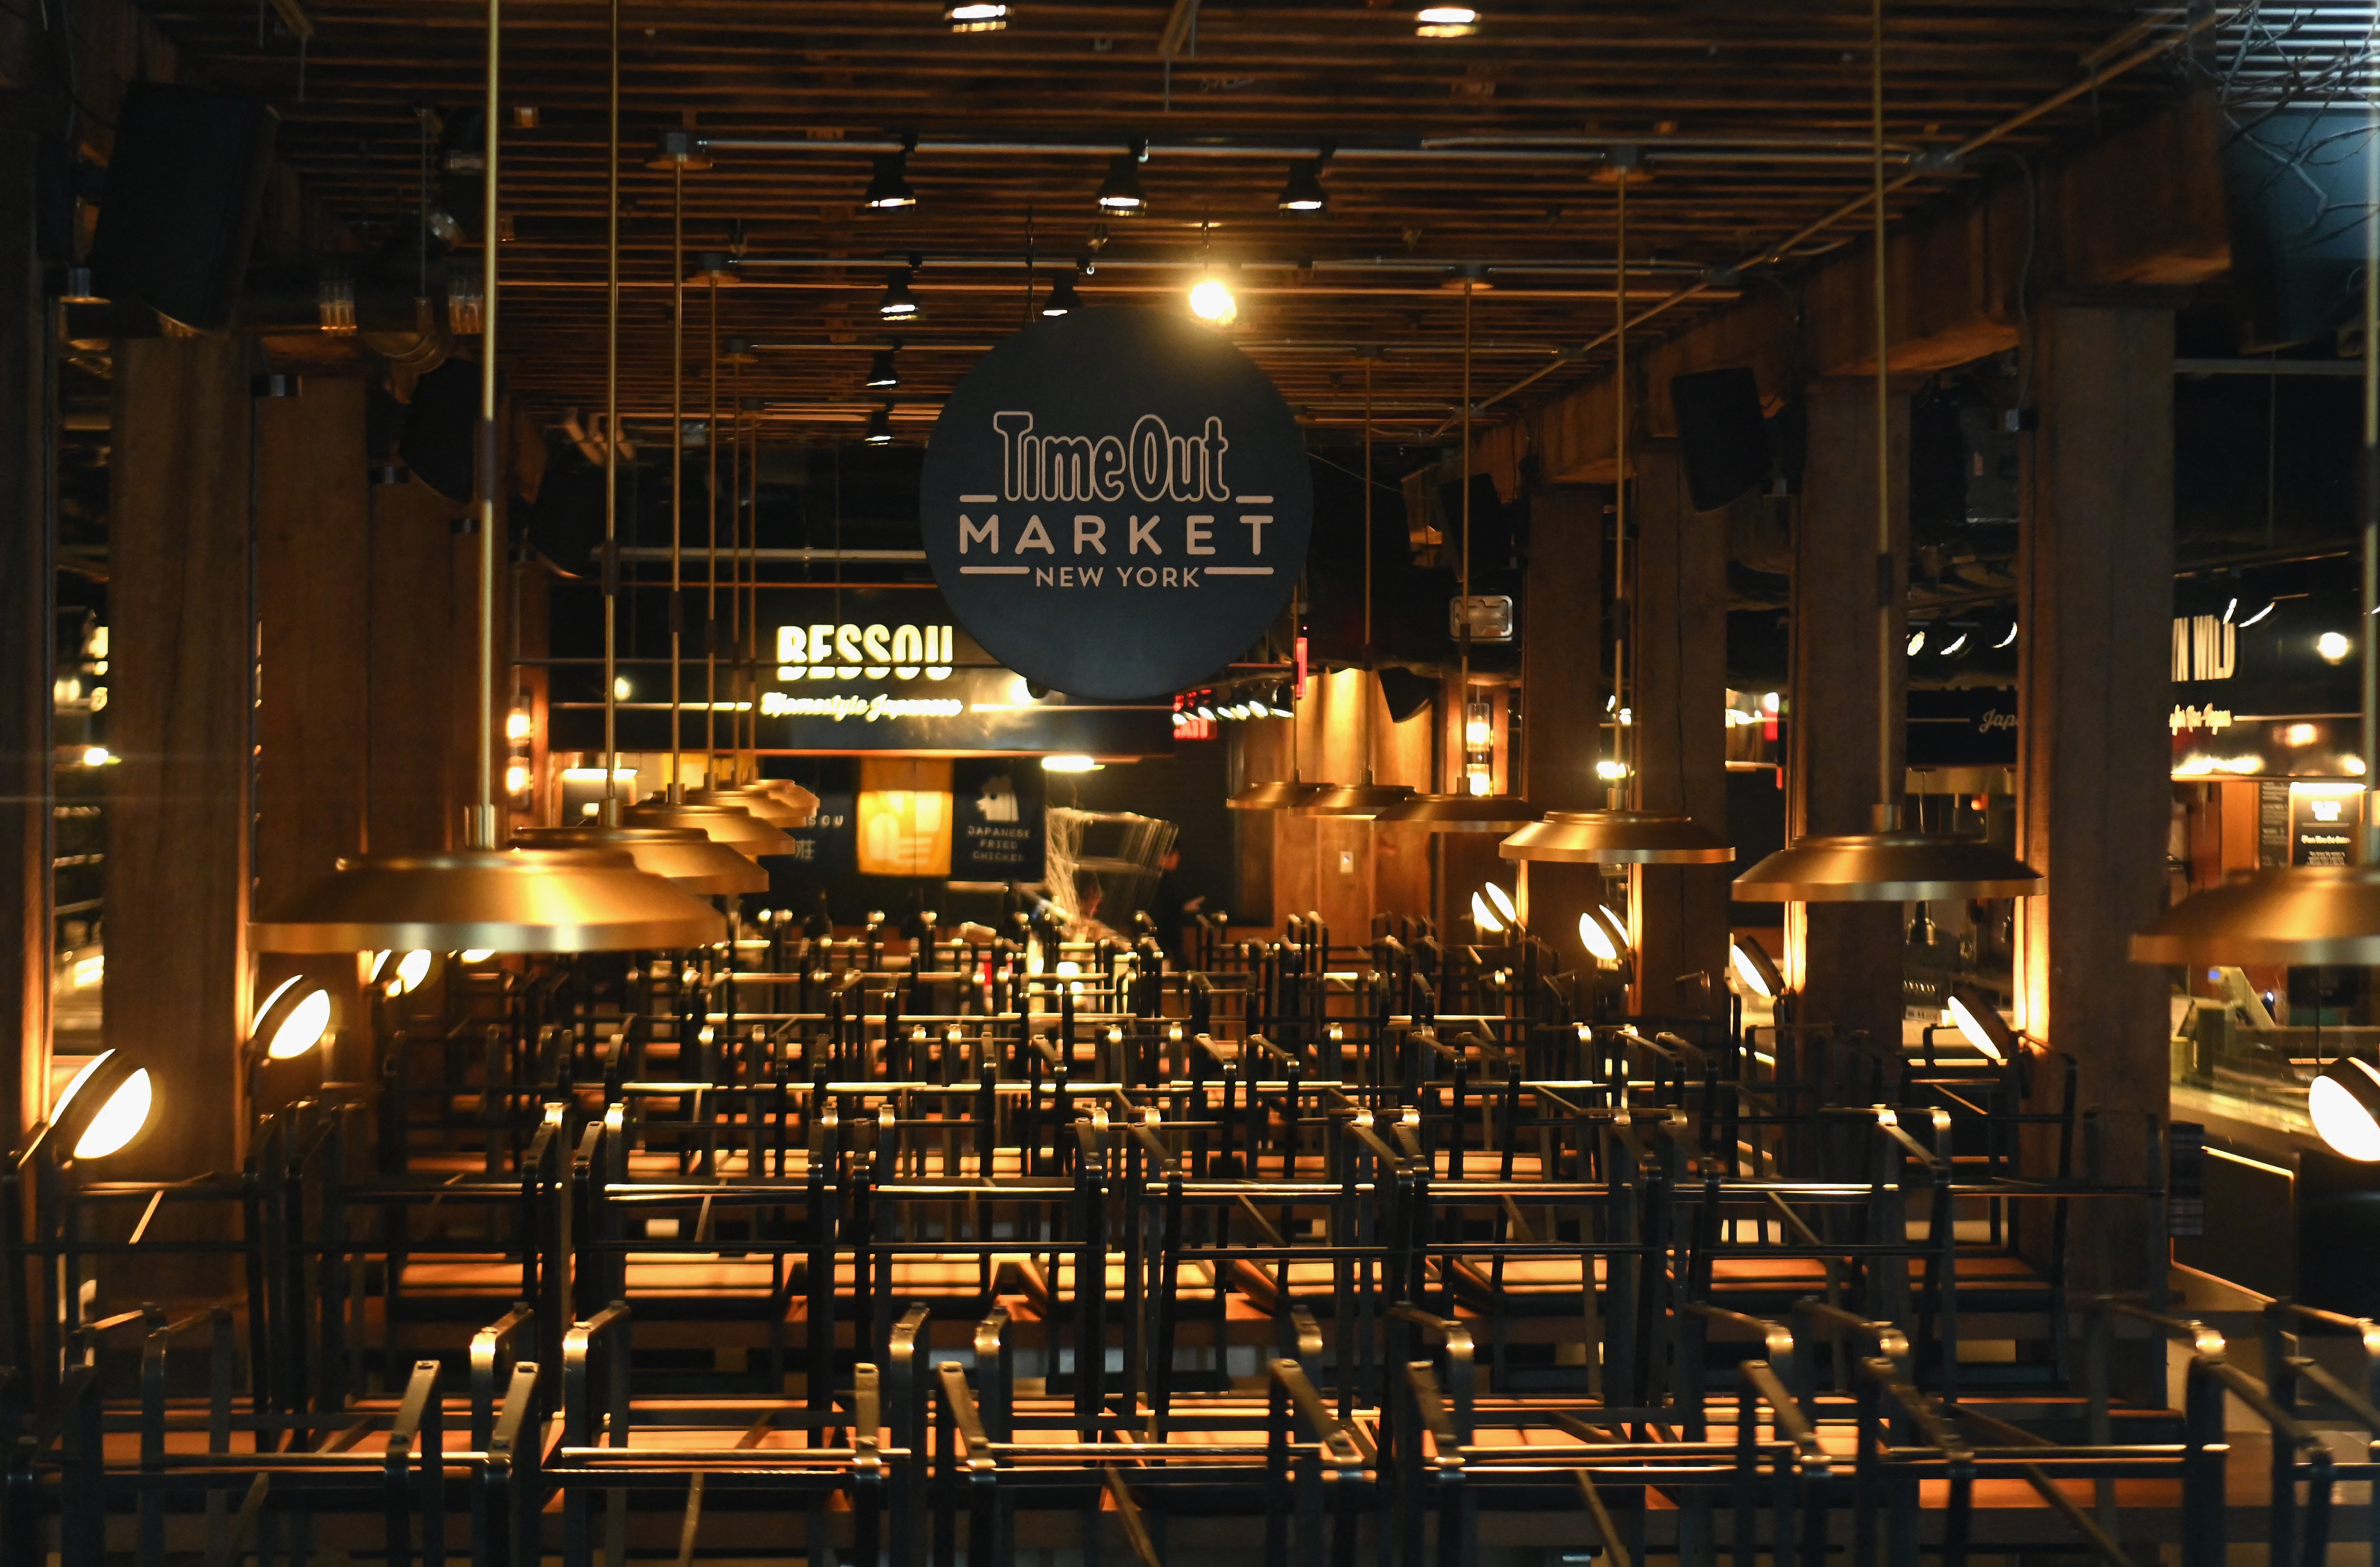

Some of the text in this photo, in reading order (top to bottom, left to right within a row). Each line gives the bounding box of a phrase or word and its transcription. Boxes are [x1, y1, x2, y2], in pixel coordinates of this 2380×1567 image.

[959, 514, 1274, 556] MARKET
[1036, 566, 1200, 588] NEW YORK
[777, 624, 953, 681] BESSOU
[2193, 614, 2235, 681] WILD
[761, 692, 869, 722] Homestyle
[1978, 708, 2018, 733] Jap
[967, 825, 1031, 838] JAPANESE
[979, 839, 1019, 850] FRIED
